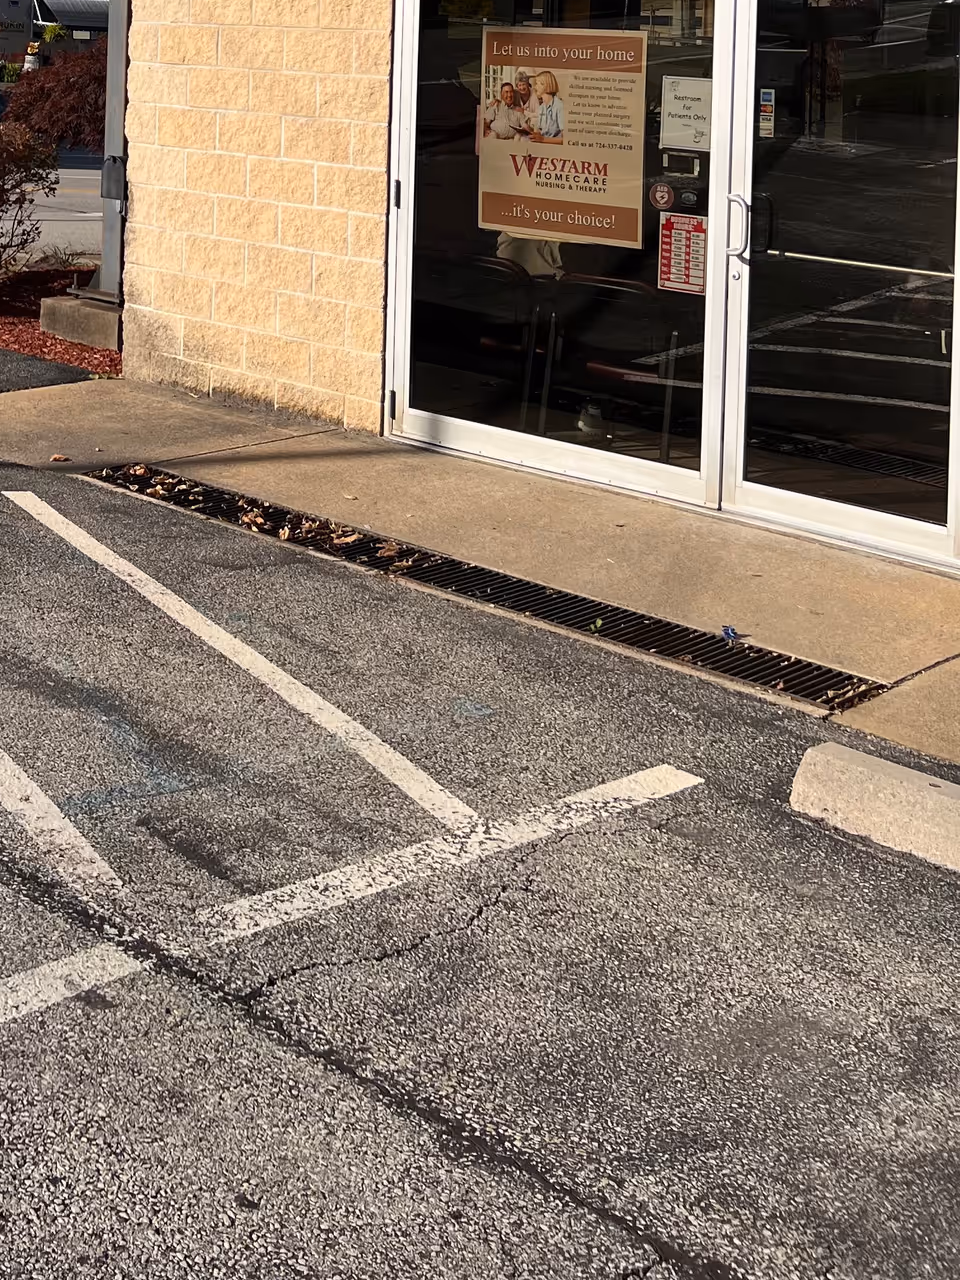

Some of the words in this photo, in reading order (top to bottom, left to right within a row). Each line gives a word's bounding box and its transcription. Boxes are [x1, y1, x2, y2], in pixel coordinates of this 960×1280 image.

[493, 42, 512, 56] Let
[517, 45, 530, 57] us
[534, 43, 558, 57] into
[562, 48, 593, 61] your
[597, 46, 635, 61] home
[668, 112, 692, 120] Patients
[693, 114, 707, 122] Only
[509, 154, 608, 178] WESTARM
[536, 171, 607, 186] HOMECARE
[535, 181, 565, 190] NURSING
[576, 185, 607, 193] THERAPY
[534, 210, 563, 223] your
[567, 211, 615, 228] choice!
